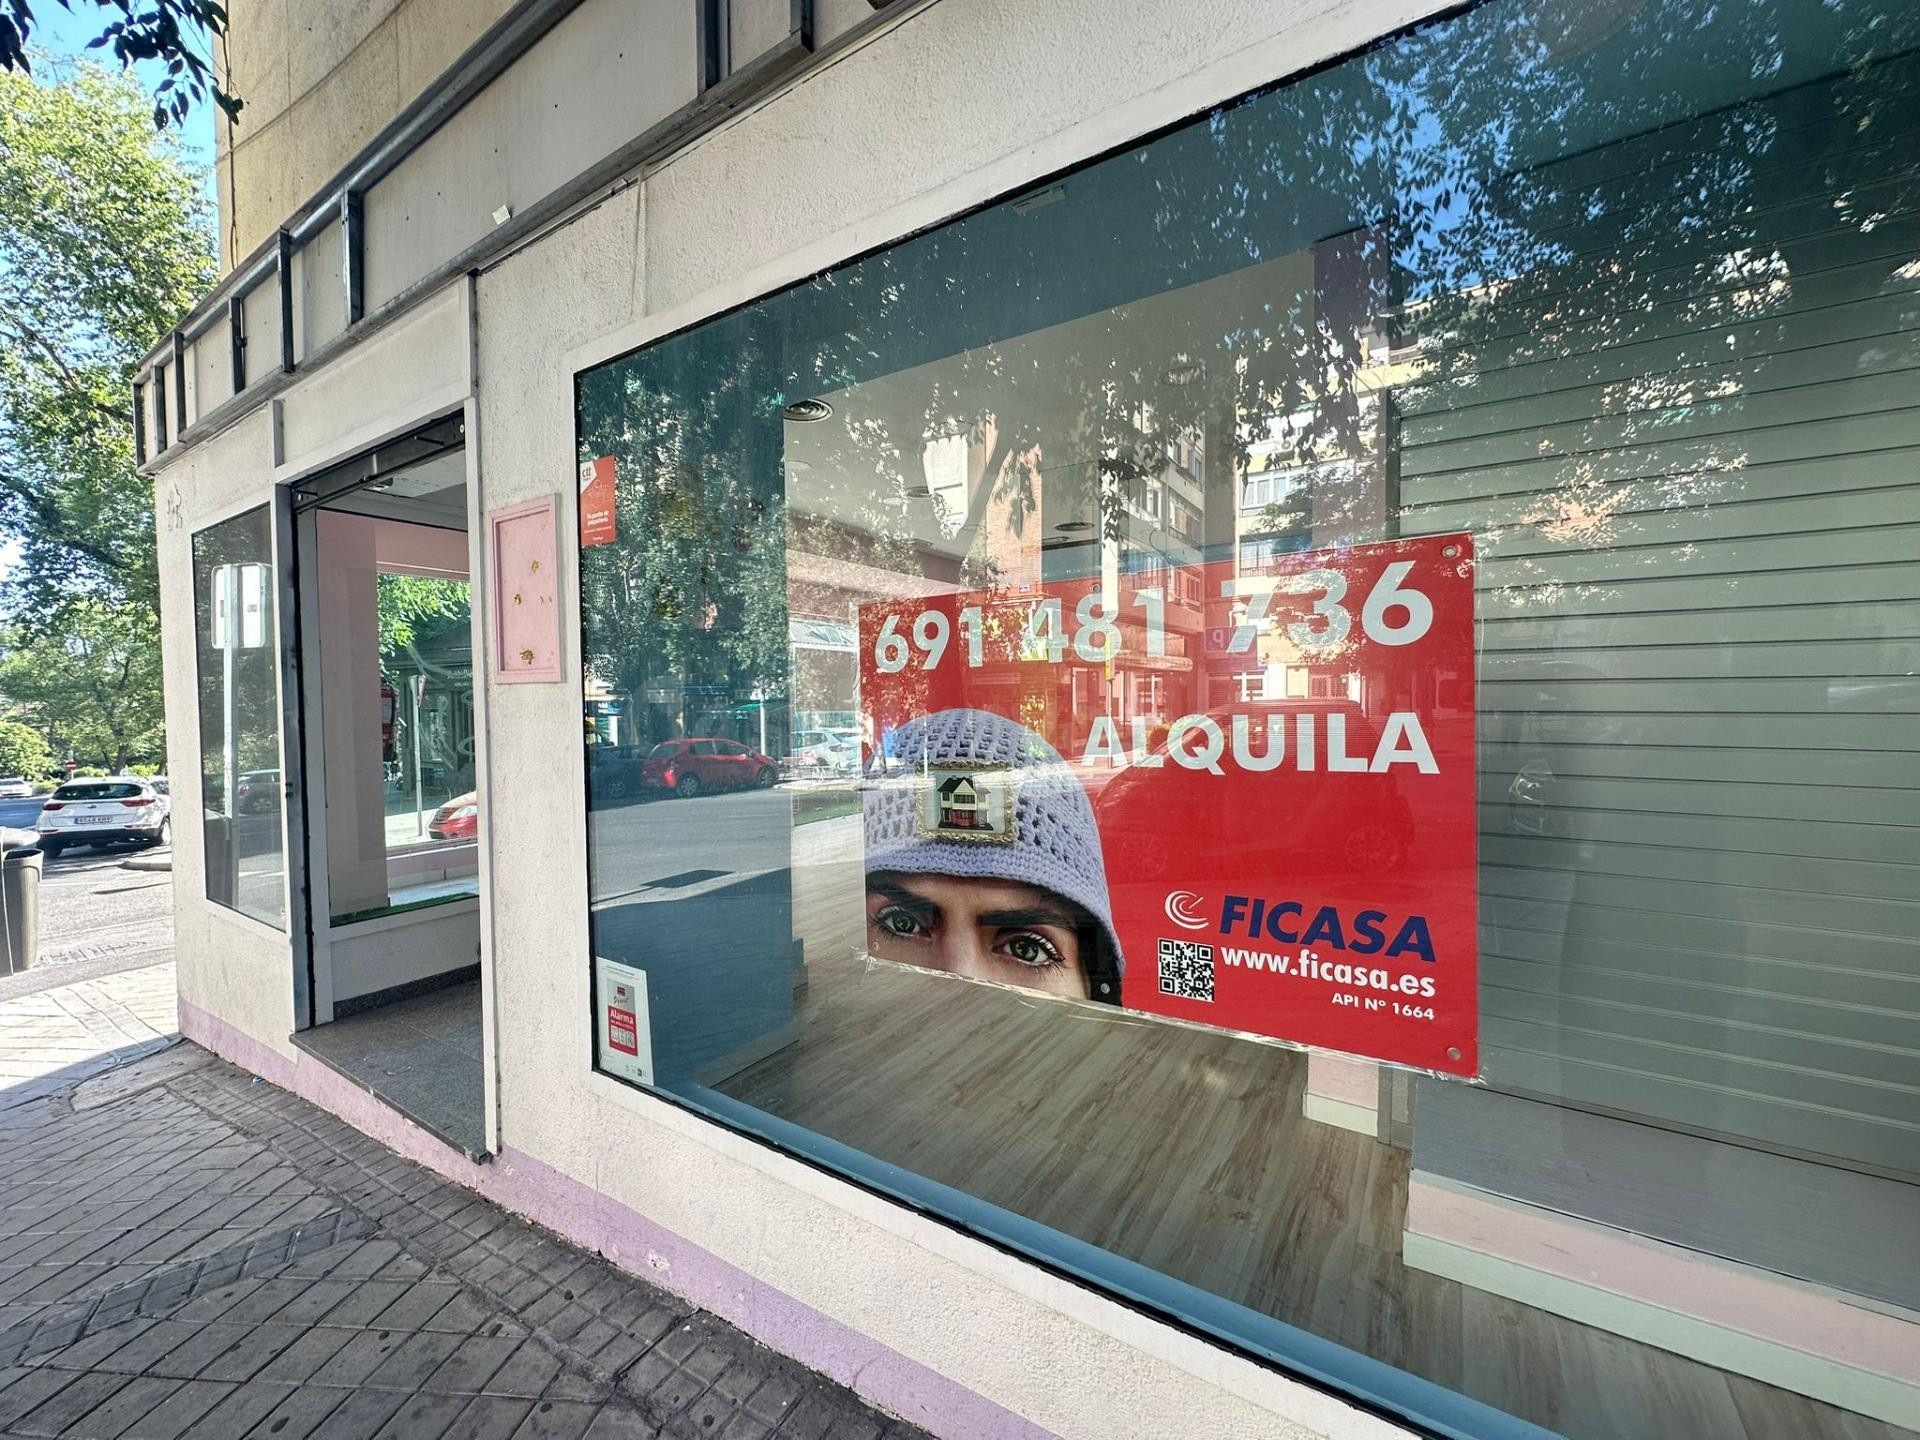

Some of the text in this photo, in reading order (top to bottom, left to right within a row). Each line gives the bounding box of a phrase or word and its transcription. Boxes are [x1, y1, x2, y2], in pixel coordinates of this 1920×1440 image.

[875, 561, 1434, 674] 691 481 736
[1081, 712, 1441, 776] ALQUILA
[1219, 895, 1437, 962] FICASA
[1221, 948, 1437, 998] www.ficasa.es
[609, 1008, 634, 1025] Alarma
[1331, 992, 1359, 1008] API
[1391, 1002, 1435, 1020] 1664
